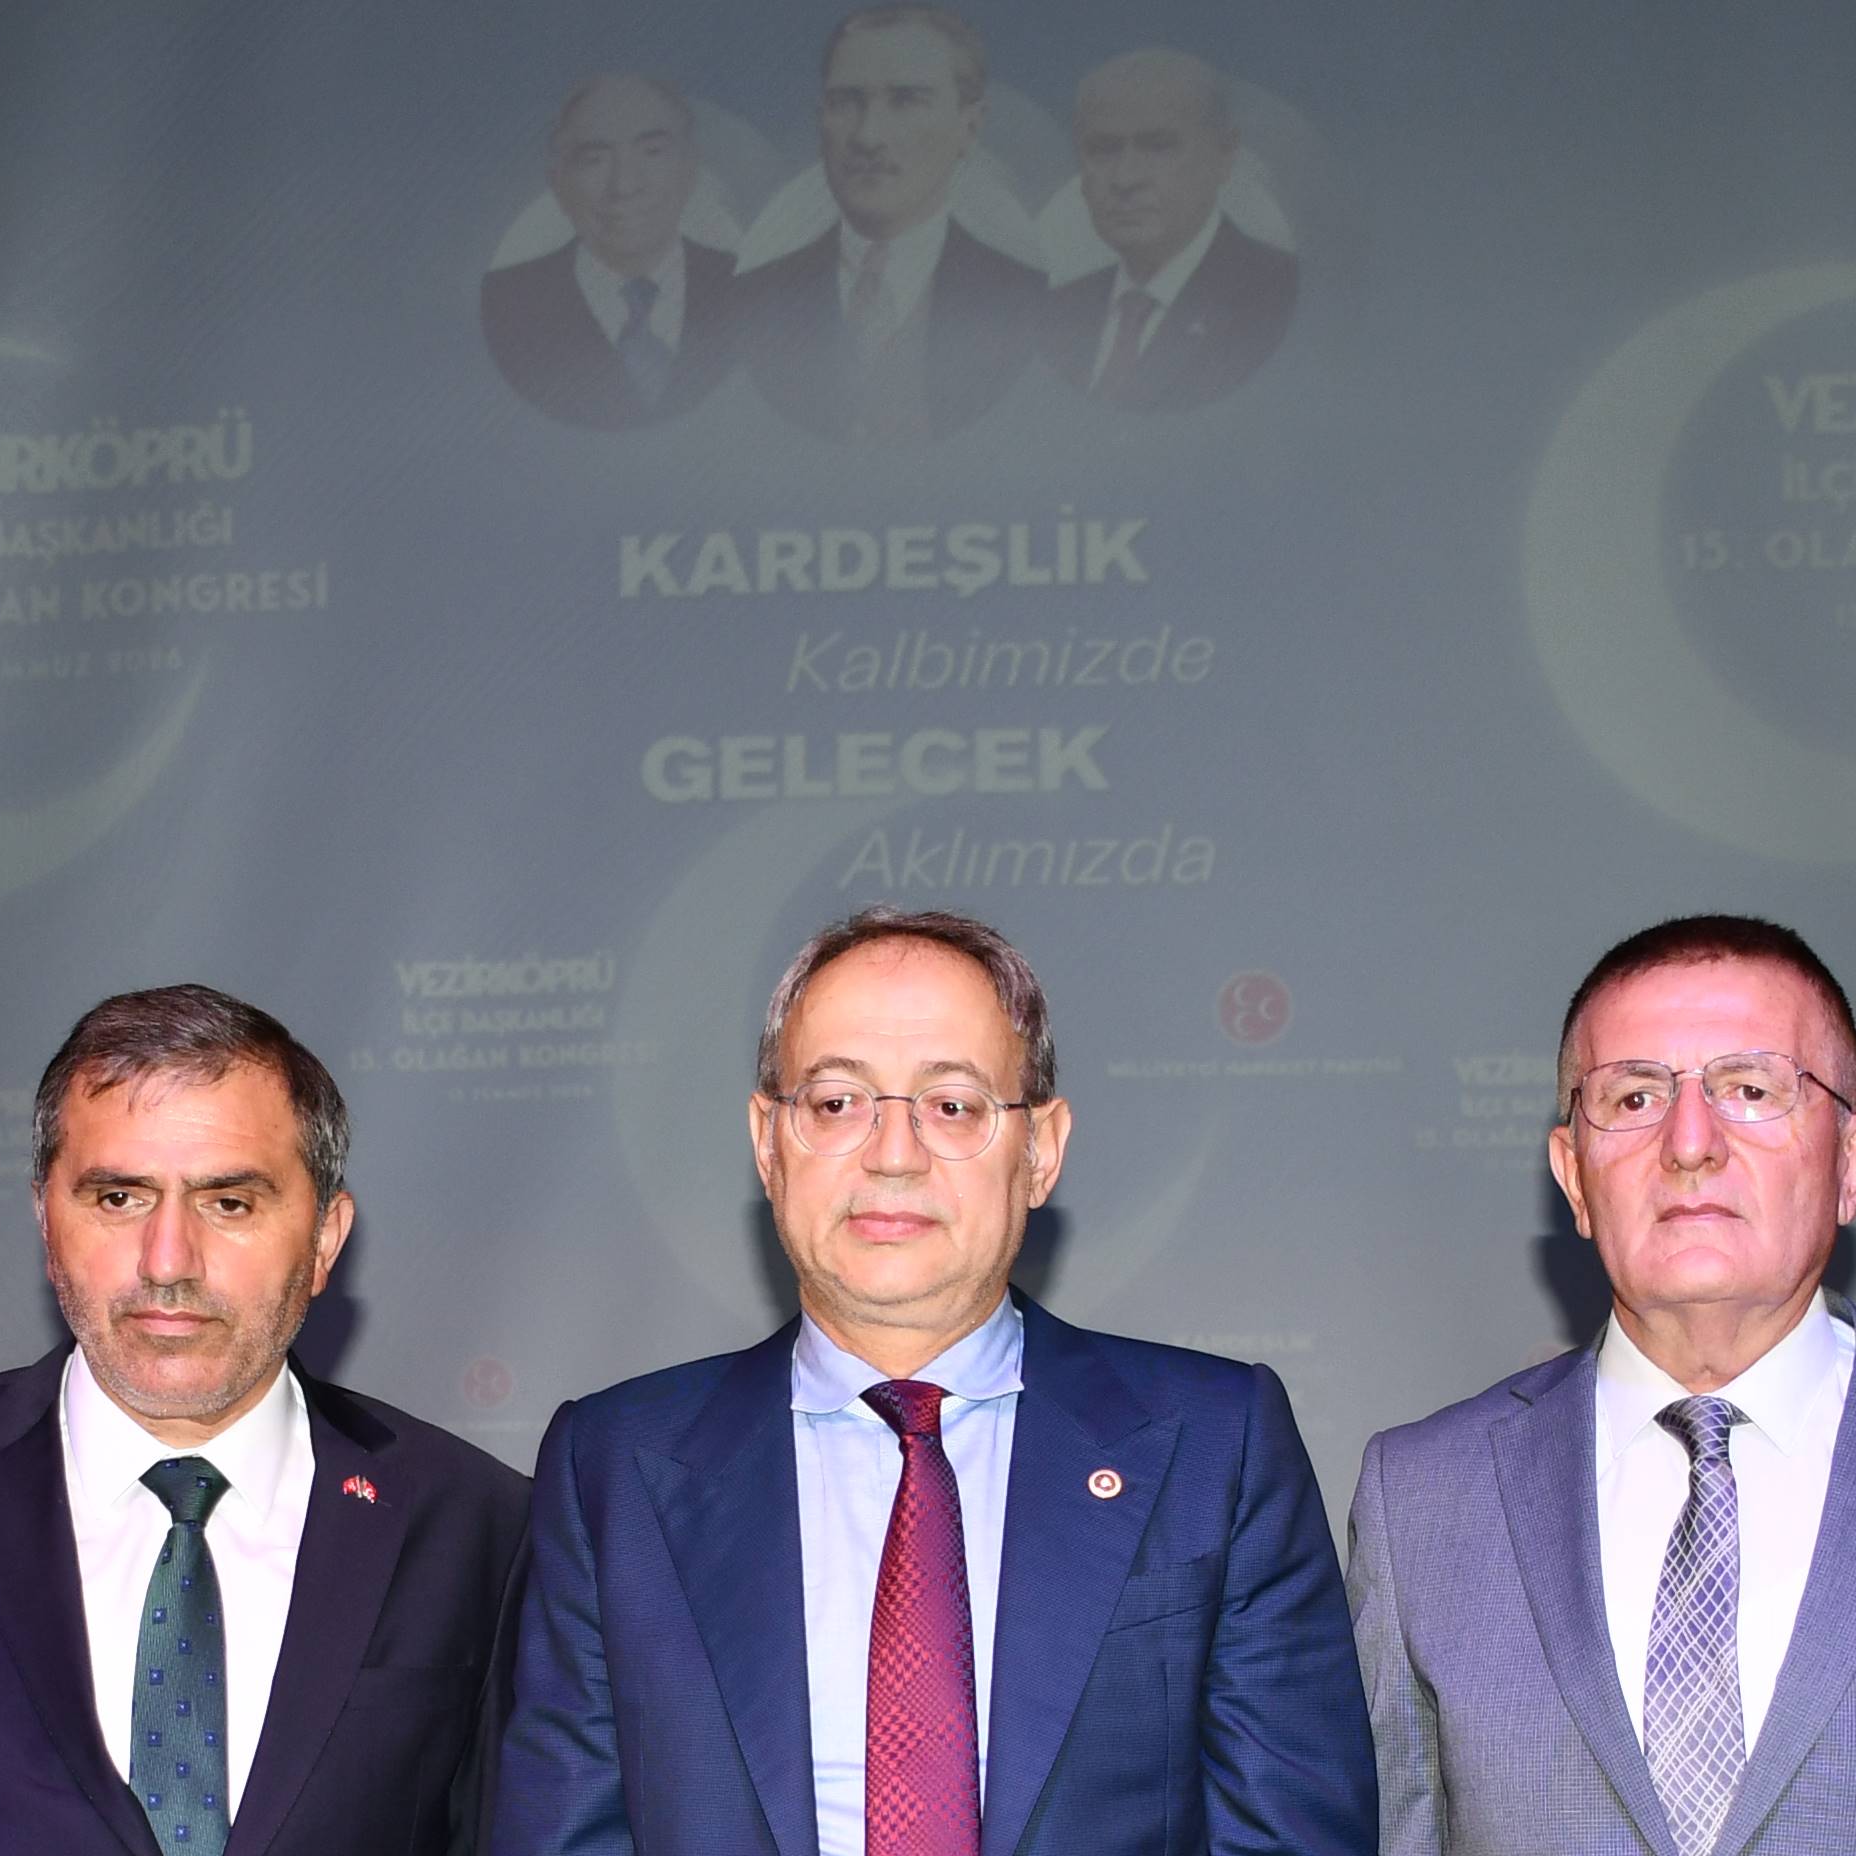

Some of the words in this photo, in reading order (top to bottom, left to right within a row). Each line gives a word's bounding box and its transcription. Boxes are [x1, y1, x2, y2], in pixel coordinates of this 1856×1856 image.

[618, 504, 1150, 598] KARDEŞLİK
[80, 561, 331, 621] KONGRESİ
[783, 625, 1218, 694] Kalbimizde
[641, 724, 1111, 803] GELECEK
[837, 826, 1218, 891] Aklımızda
